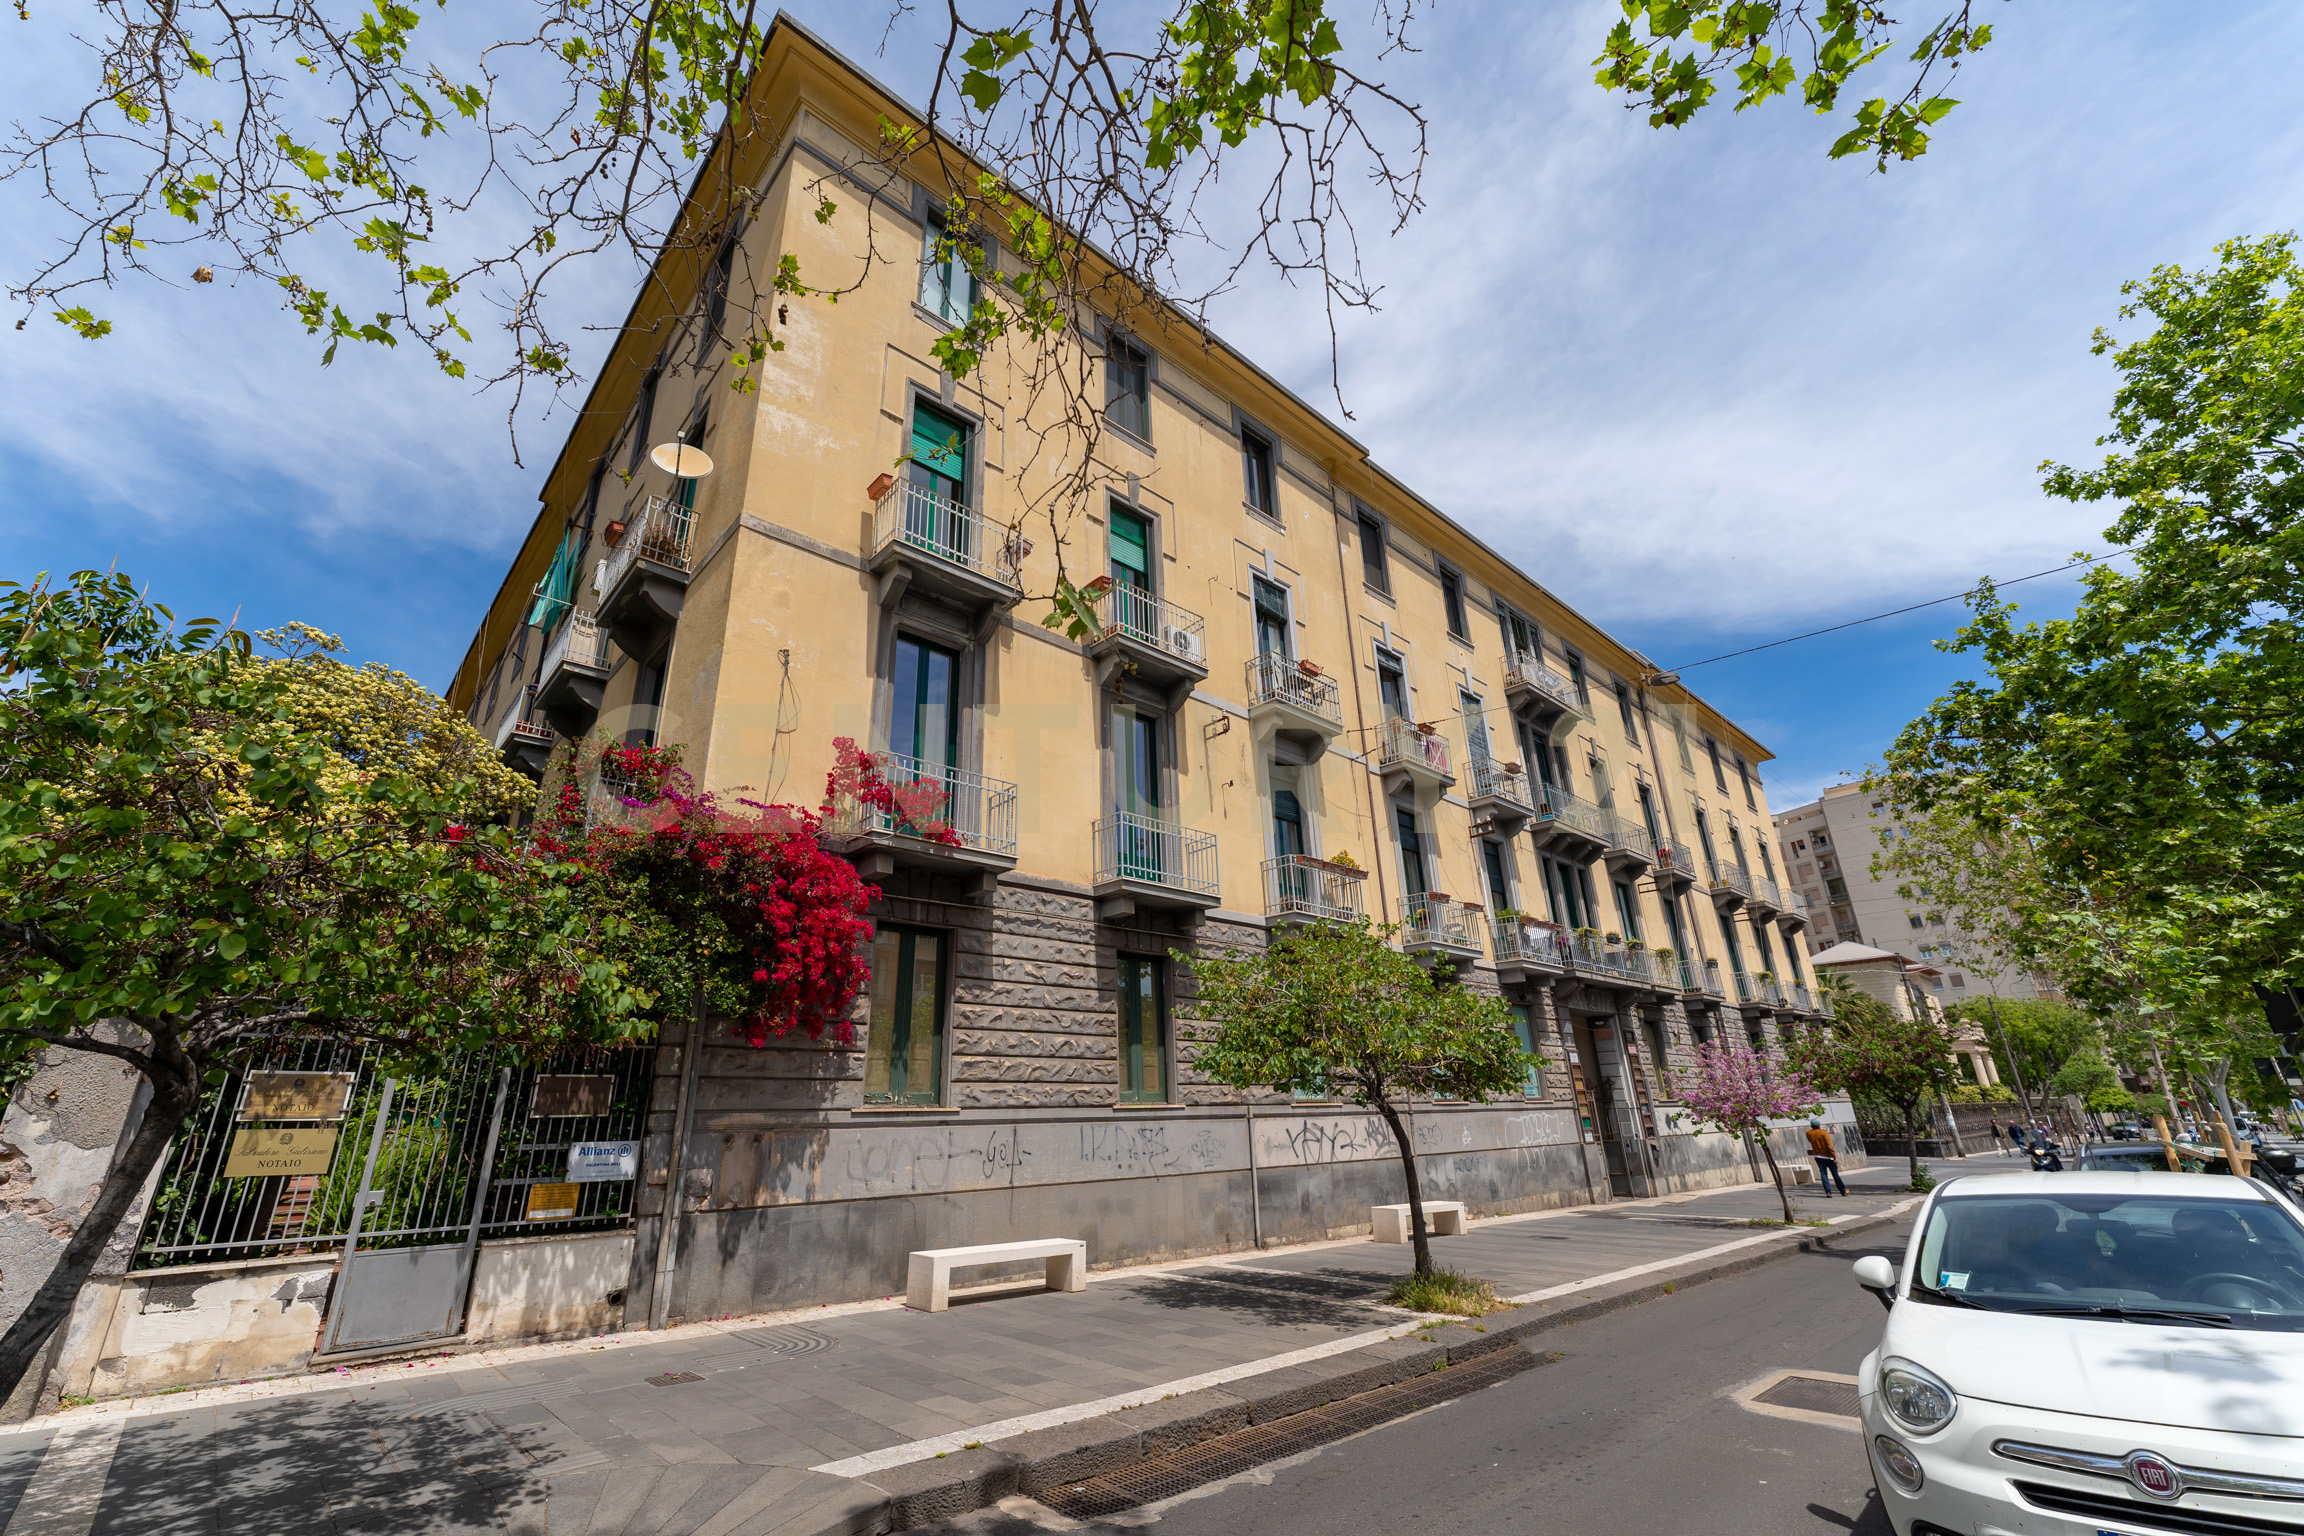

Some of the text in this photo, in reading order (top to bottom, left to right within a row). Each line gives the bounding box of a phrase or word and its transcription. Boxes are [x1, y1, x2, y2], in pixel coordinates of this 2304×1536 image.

[272, 1103, 315, 1112] NOTAIO
[234, 1145, 328, 1157] Salvatore Gulisano
[578, 1146, 616, 1157] Allianz
[257, 1159, 302, 1168] NOTAIO
[2140, 1467, 2167, 1486] FIAT
